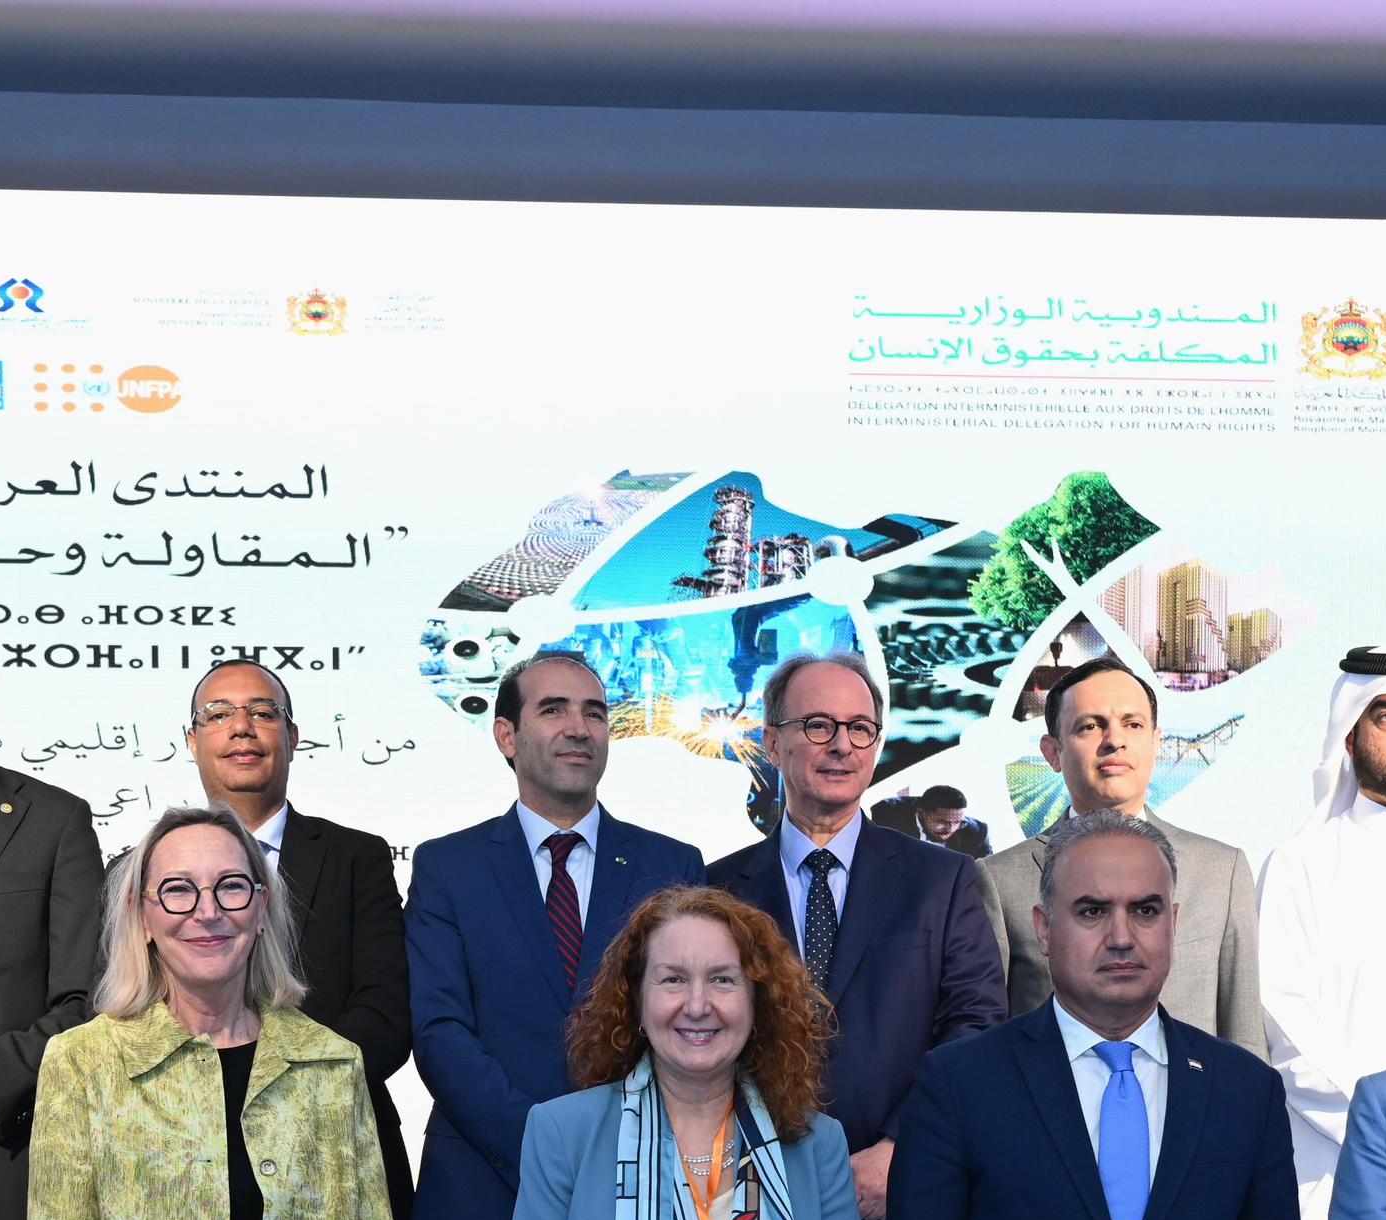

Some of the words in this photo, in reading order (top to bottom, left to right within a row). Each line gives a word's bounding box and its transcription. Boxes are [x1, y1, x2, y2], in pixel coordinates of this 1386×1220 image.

[852, 295, 1063, 327] الوزارية
[1072, 299, 1278, 328] المندوبية
[848, 335, 973, 365] الإنسان
[981, 337, 1102, 369] بحقوق
[1107, 339, 1278, 366] المكلفة
[116, 379, 182, 399] UNFPA
[1095, 404, 1126, 414] AUX
[1130, 405, 1182, 415] DROITS
[1187, 406, 1205, 415] DE
[1147, 421, 1212, 431] HUMAN
[1218, 422, 1276, 432] RIGHTS
[113, 463, 329, 506] المنتدى
[21, 721, 143, 770] إقليمي
[295, 713, 346, 759] أج
[362, 738, 417, 765] من
